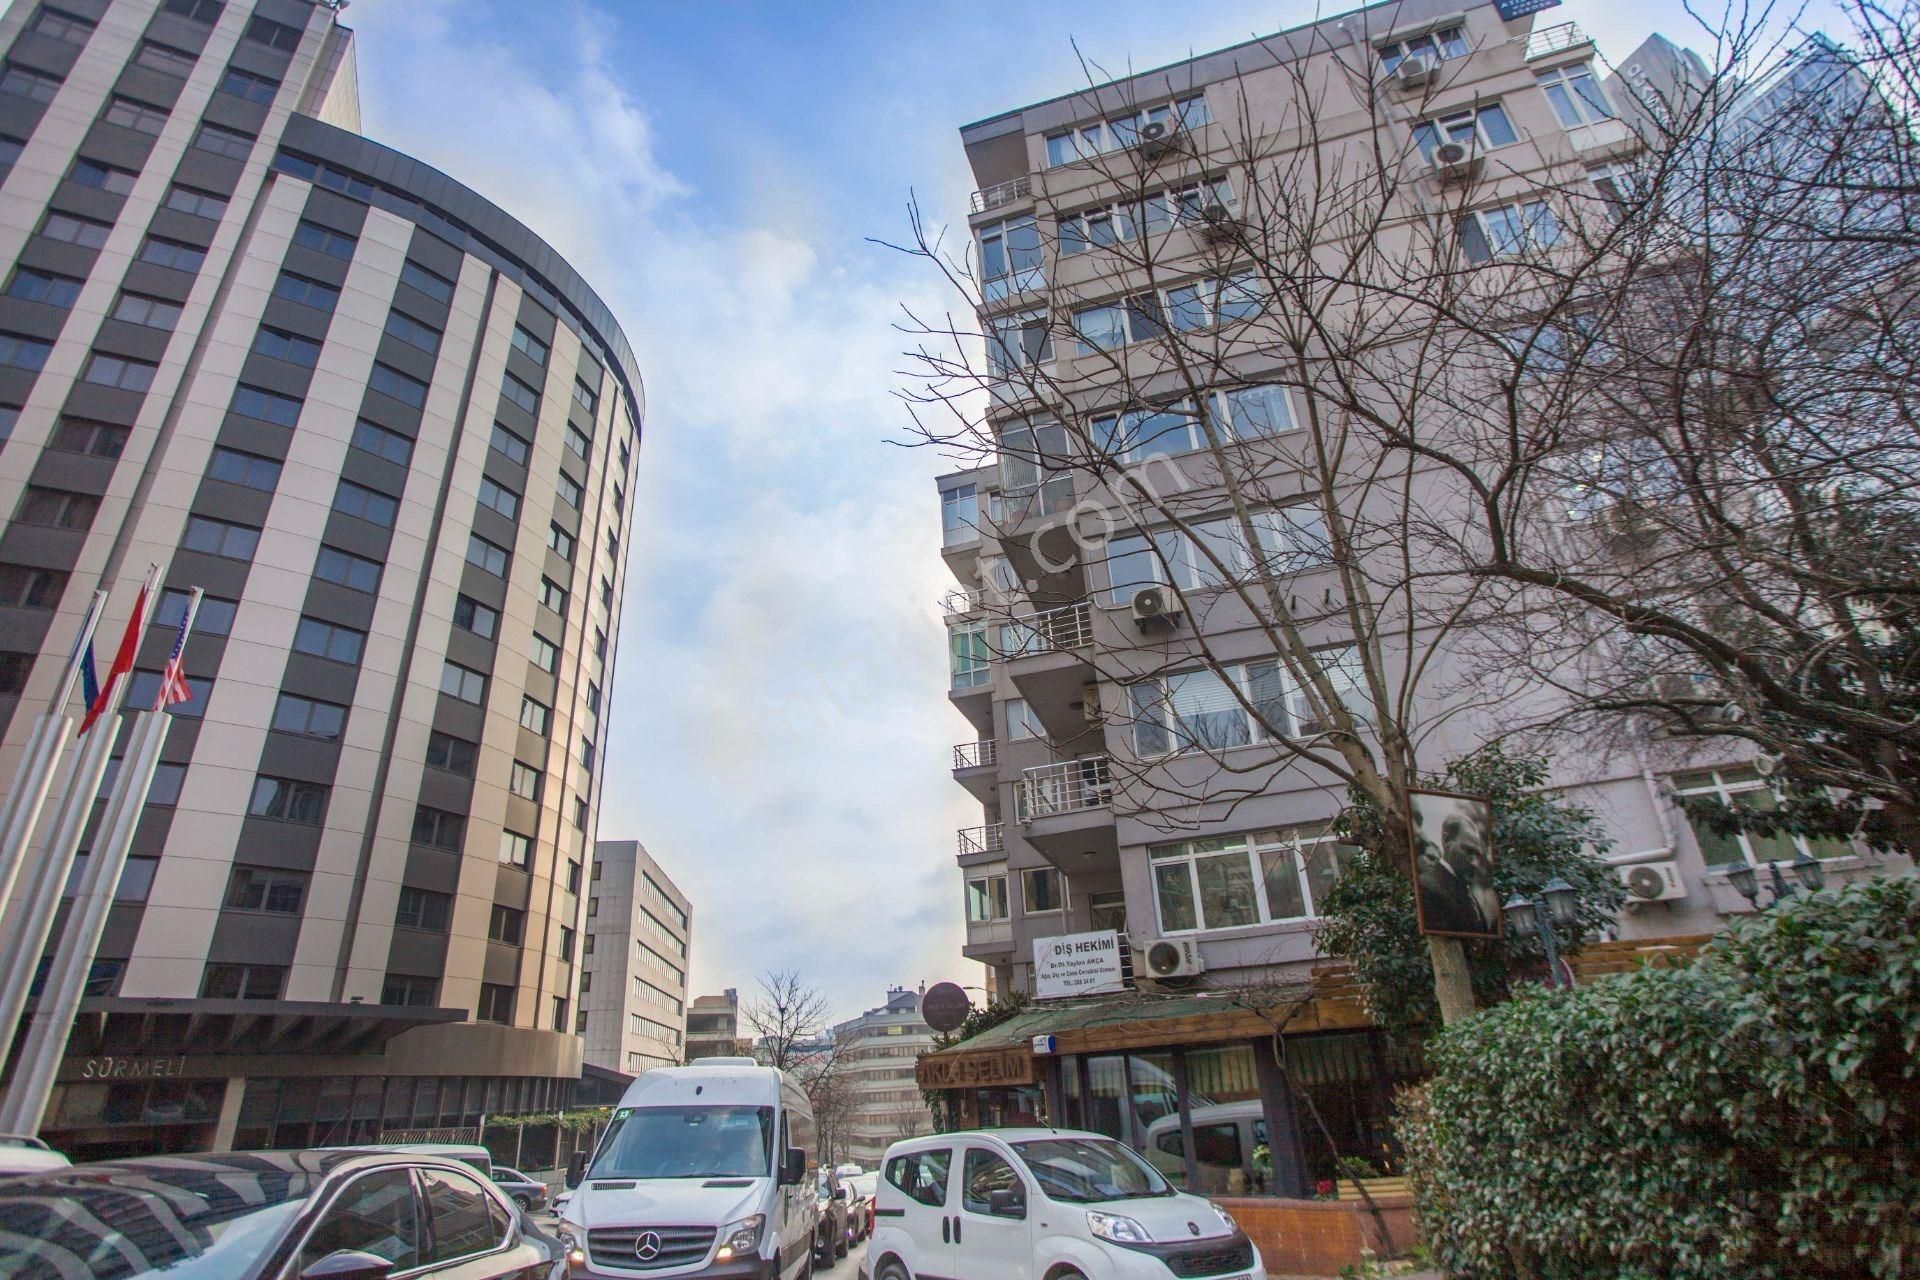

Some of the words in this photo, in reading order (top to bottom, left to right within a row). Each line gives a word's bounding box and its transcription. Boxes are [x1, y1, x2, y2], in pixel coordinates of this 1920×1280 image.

[1055, 942, 1073, 957] DİŞ
[1075, 937, 1115, 953] HEKİMİ
[82, 1056, 186, 1078] SÜRMELİ
